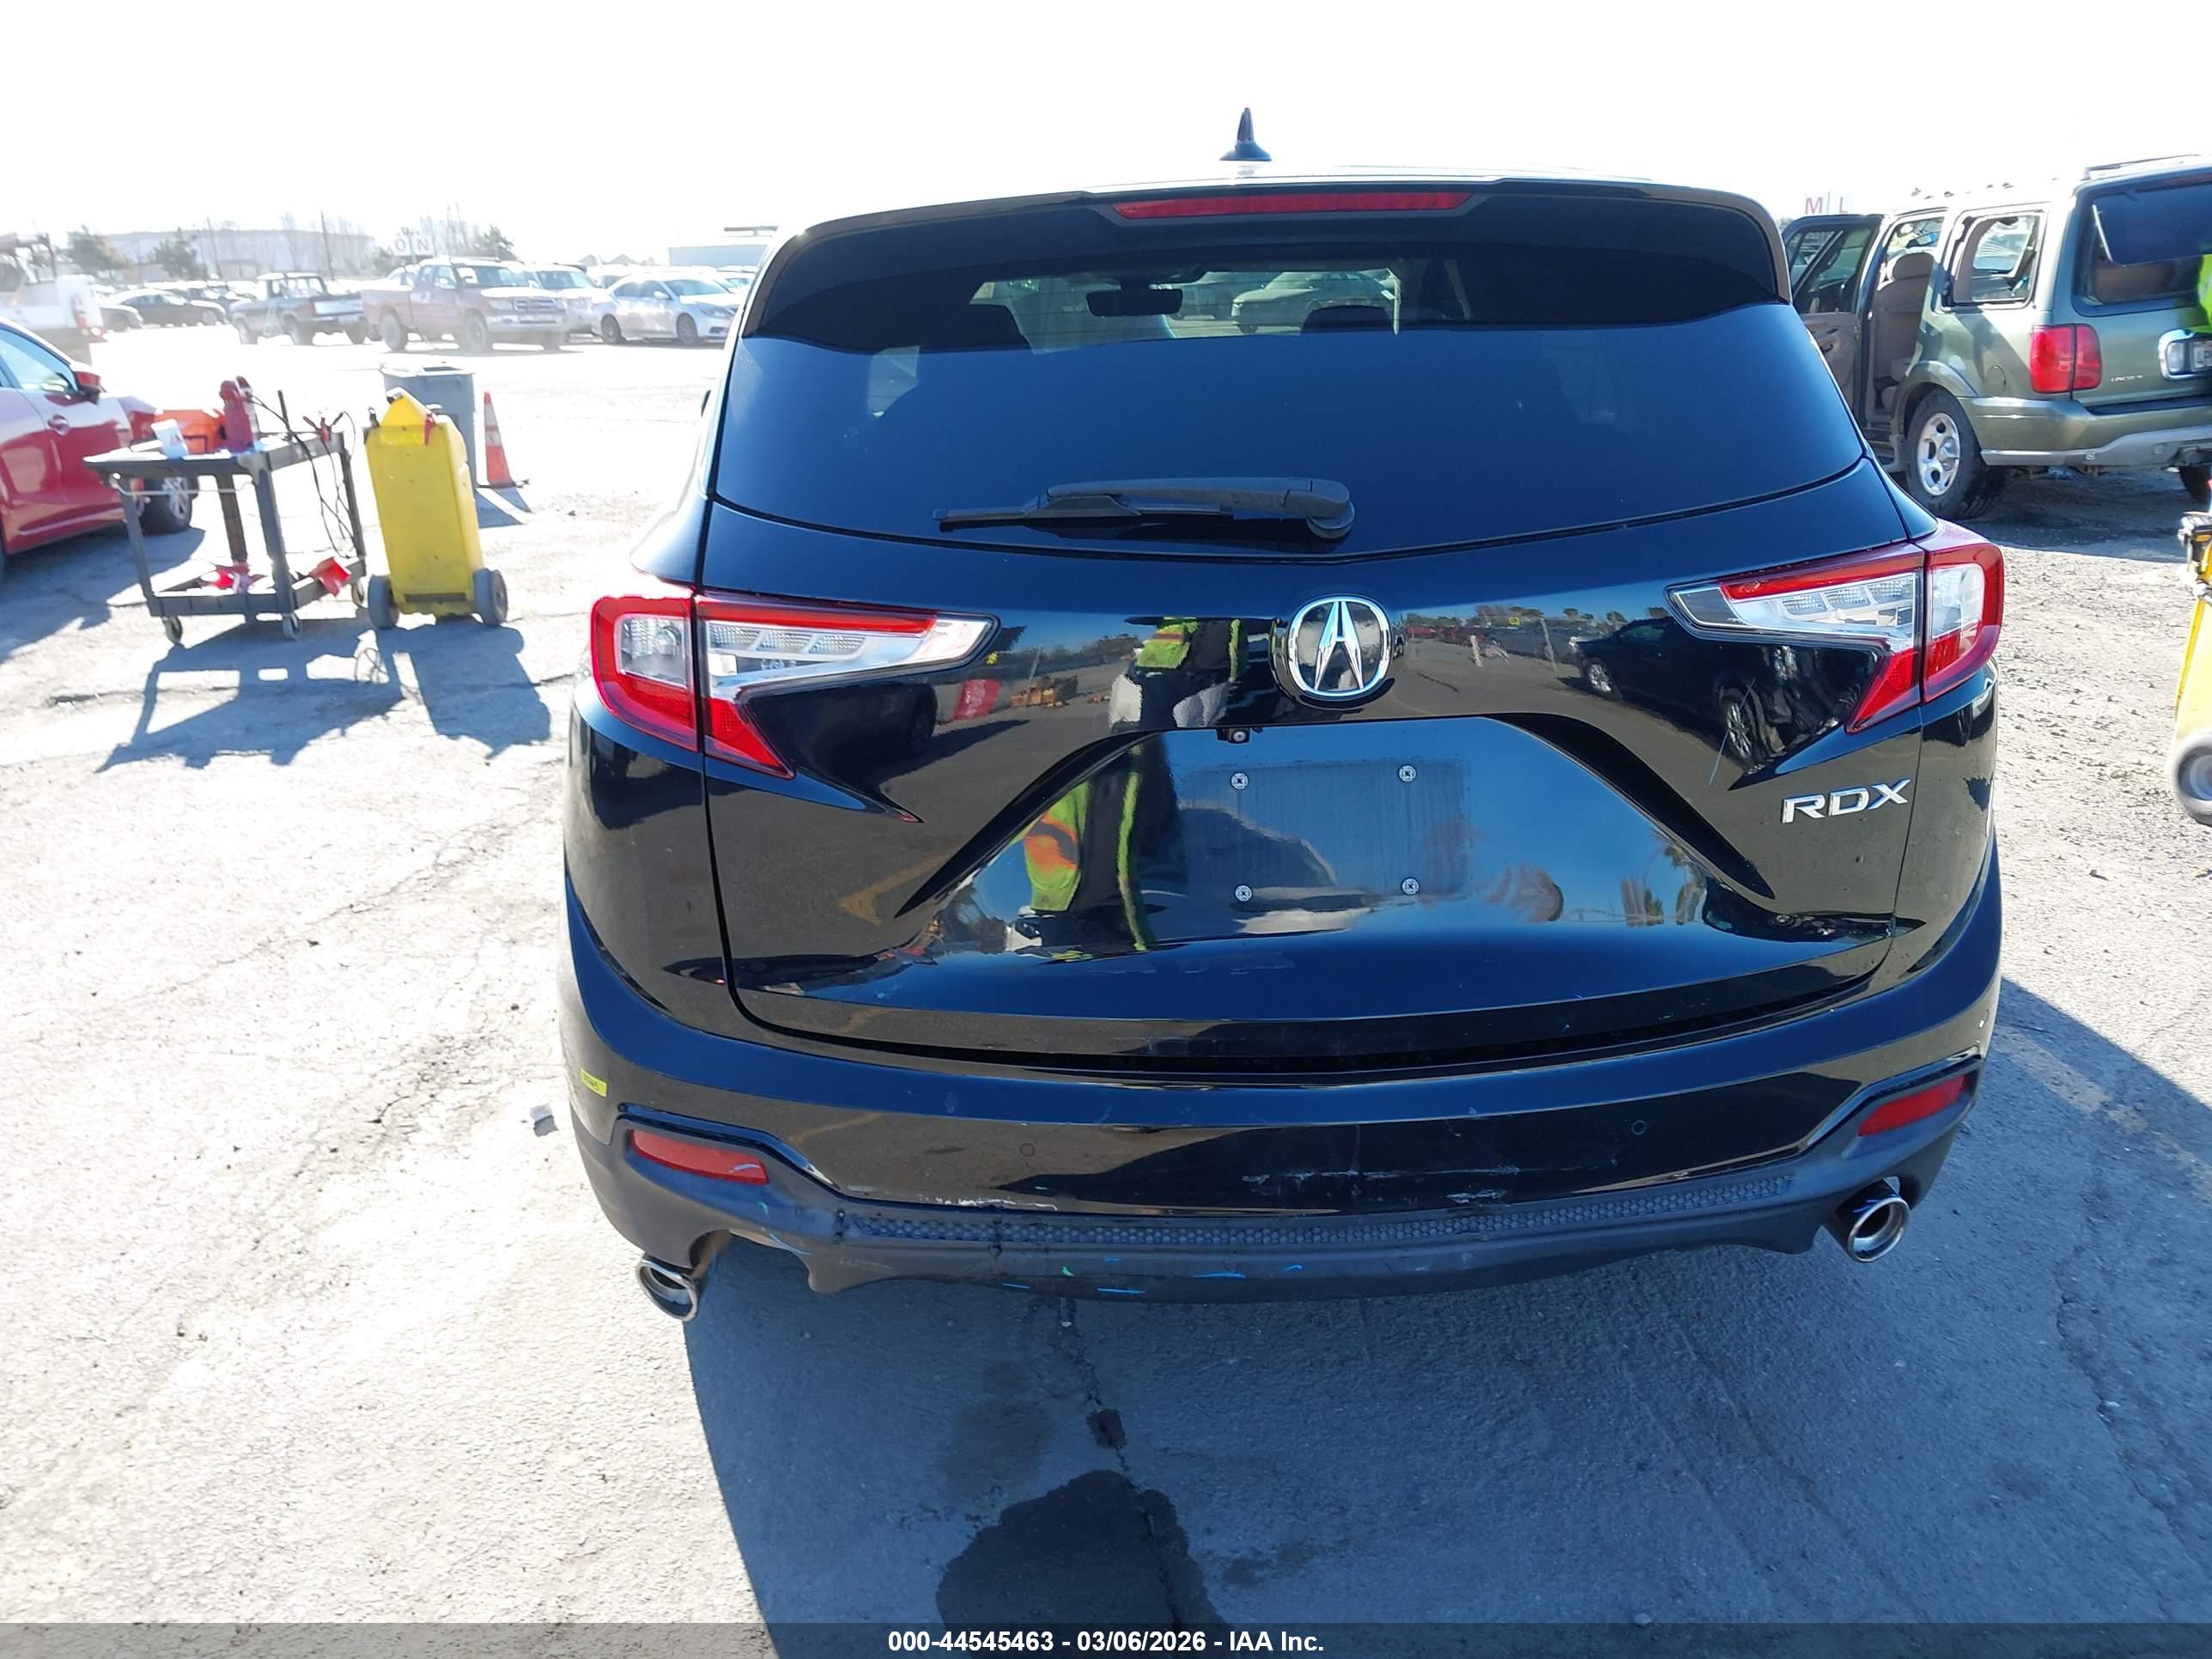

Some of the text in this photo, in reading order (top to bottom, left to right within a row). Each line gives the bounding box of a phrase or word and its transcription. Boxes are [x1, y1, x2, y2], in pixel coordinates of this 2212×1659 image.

[1804, 196, 1823, 215] M
[416, 239, 428, 252] N
[1781, 778, 1911, 824] RDX
